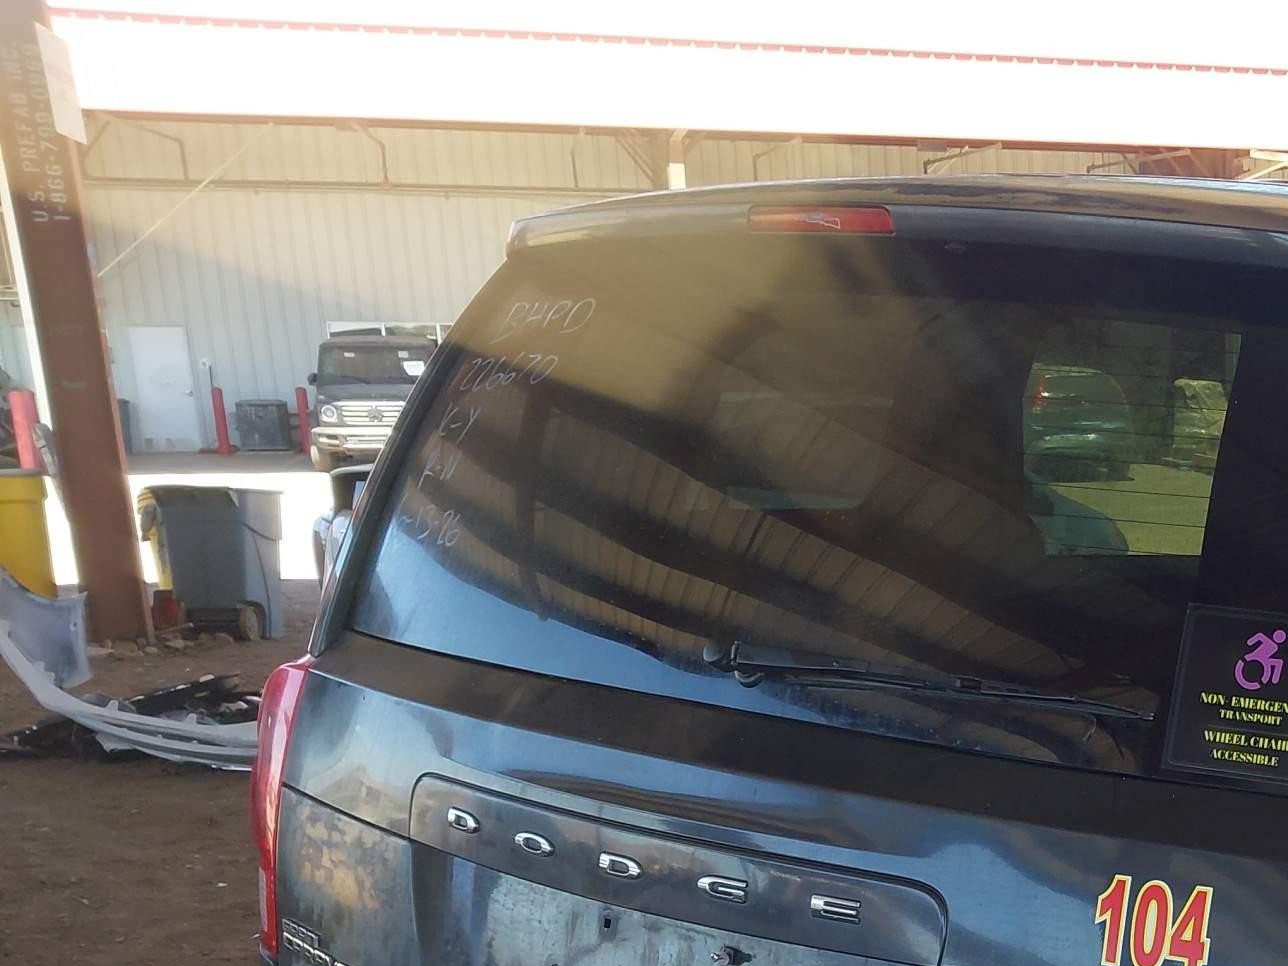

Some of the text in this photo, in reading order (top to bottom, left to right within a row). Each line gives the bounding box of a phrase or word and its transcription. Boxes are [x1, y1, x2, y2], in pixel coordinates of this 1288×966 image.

[12, 92, 41, 172] PREFAB
[1219, 708, 1283, 726] TRANSPORT
[1204, 729, 1248, 747] WHEEL
[1210, 748, 1280, 767] ACCESSIBLE
[447, 806, 862, 925] DODGE
